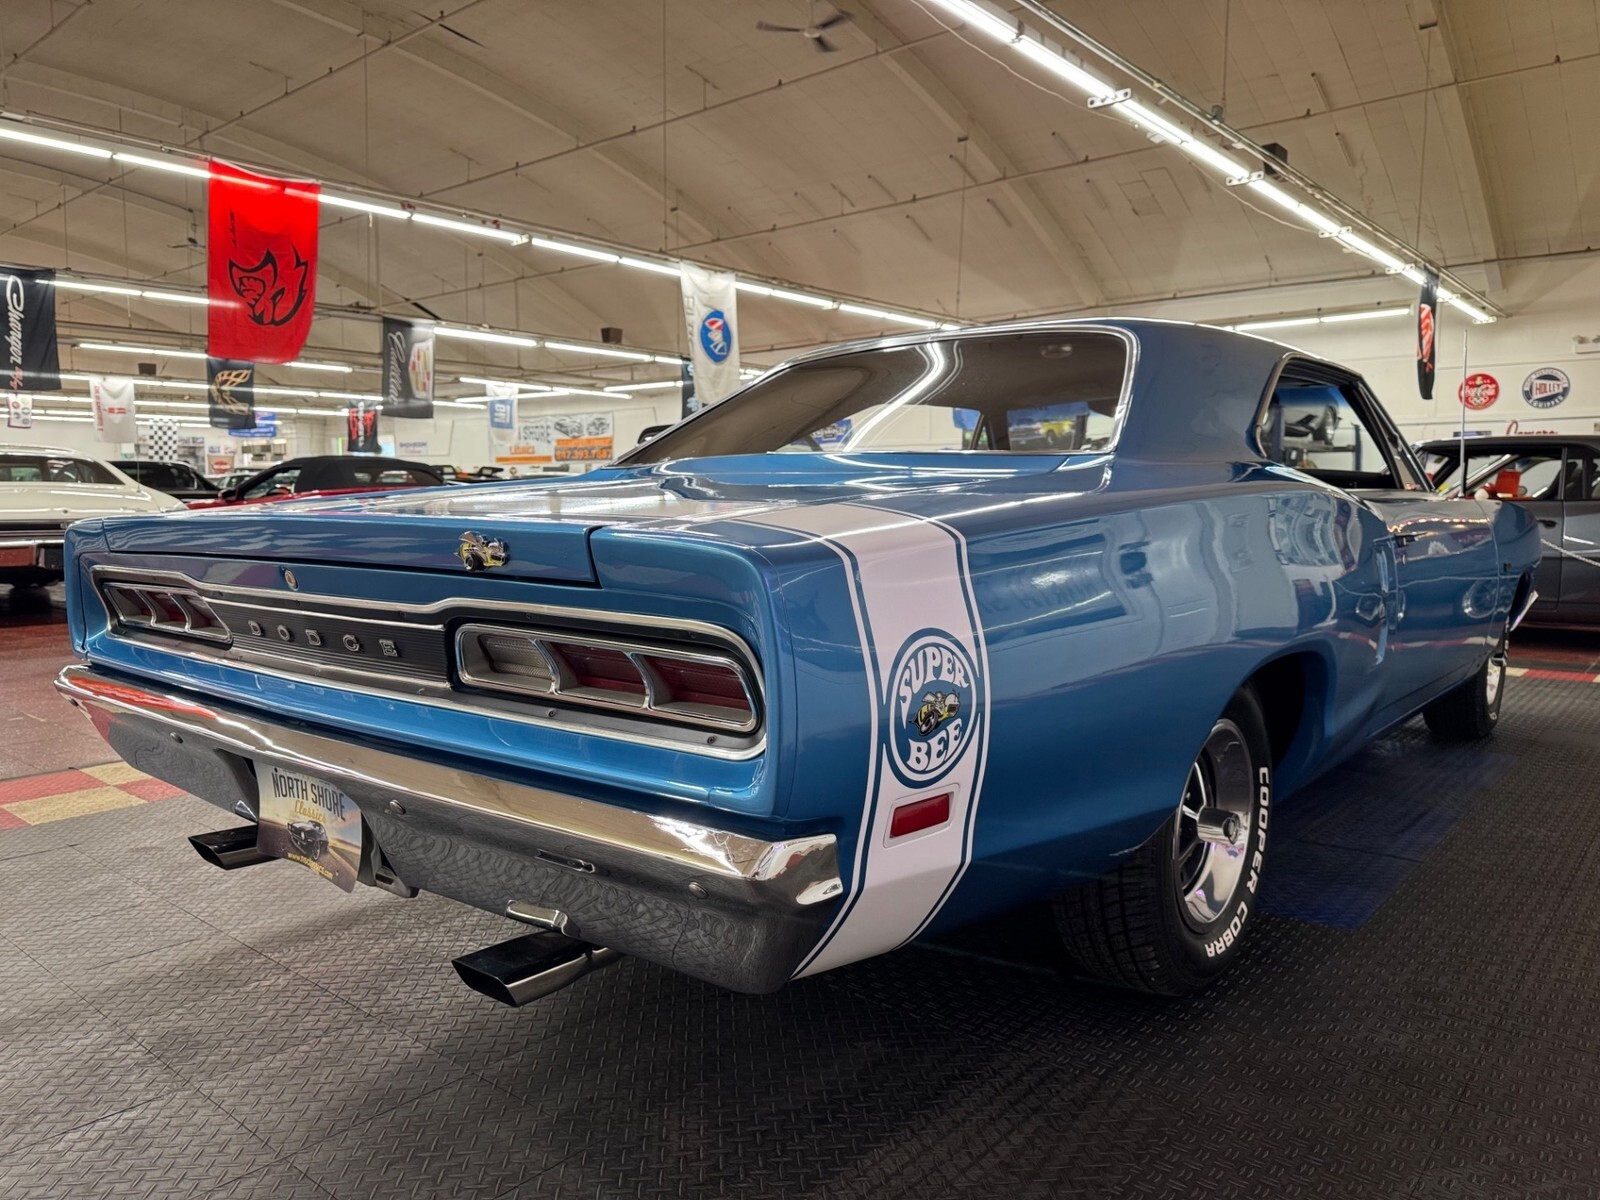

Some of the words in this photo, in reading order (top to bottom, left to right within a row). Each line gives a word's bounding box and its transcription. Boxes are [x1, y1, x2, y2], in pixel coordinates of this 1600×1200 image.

[4, 275, 24, 364] Charger
[1535, 381, 1562, 396] HOLLEY
[248, 620, 398, 657] DODGE
[899, 646, 969, 729] SUPER
[906, 718, 963, 771] BEE
[272, 771, 308, 801] NORTH
[311, 783, 346, 821] SHORE
[294, 799, 327, 824] Classics
[1246, 766, 1270, 894] COOPER
[1204, 901, 1248, 958] COBRA
